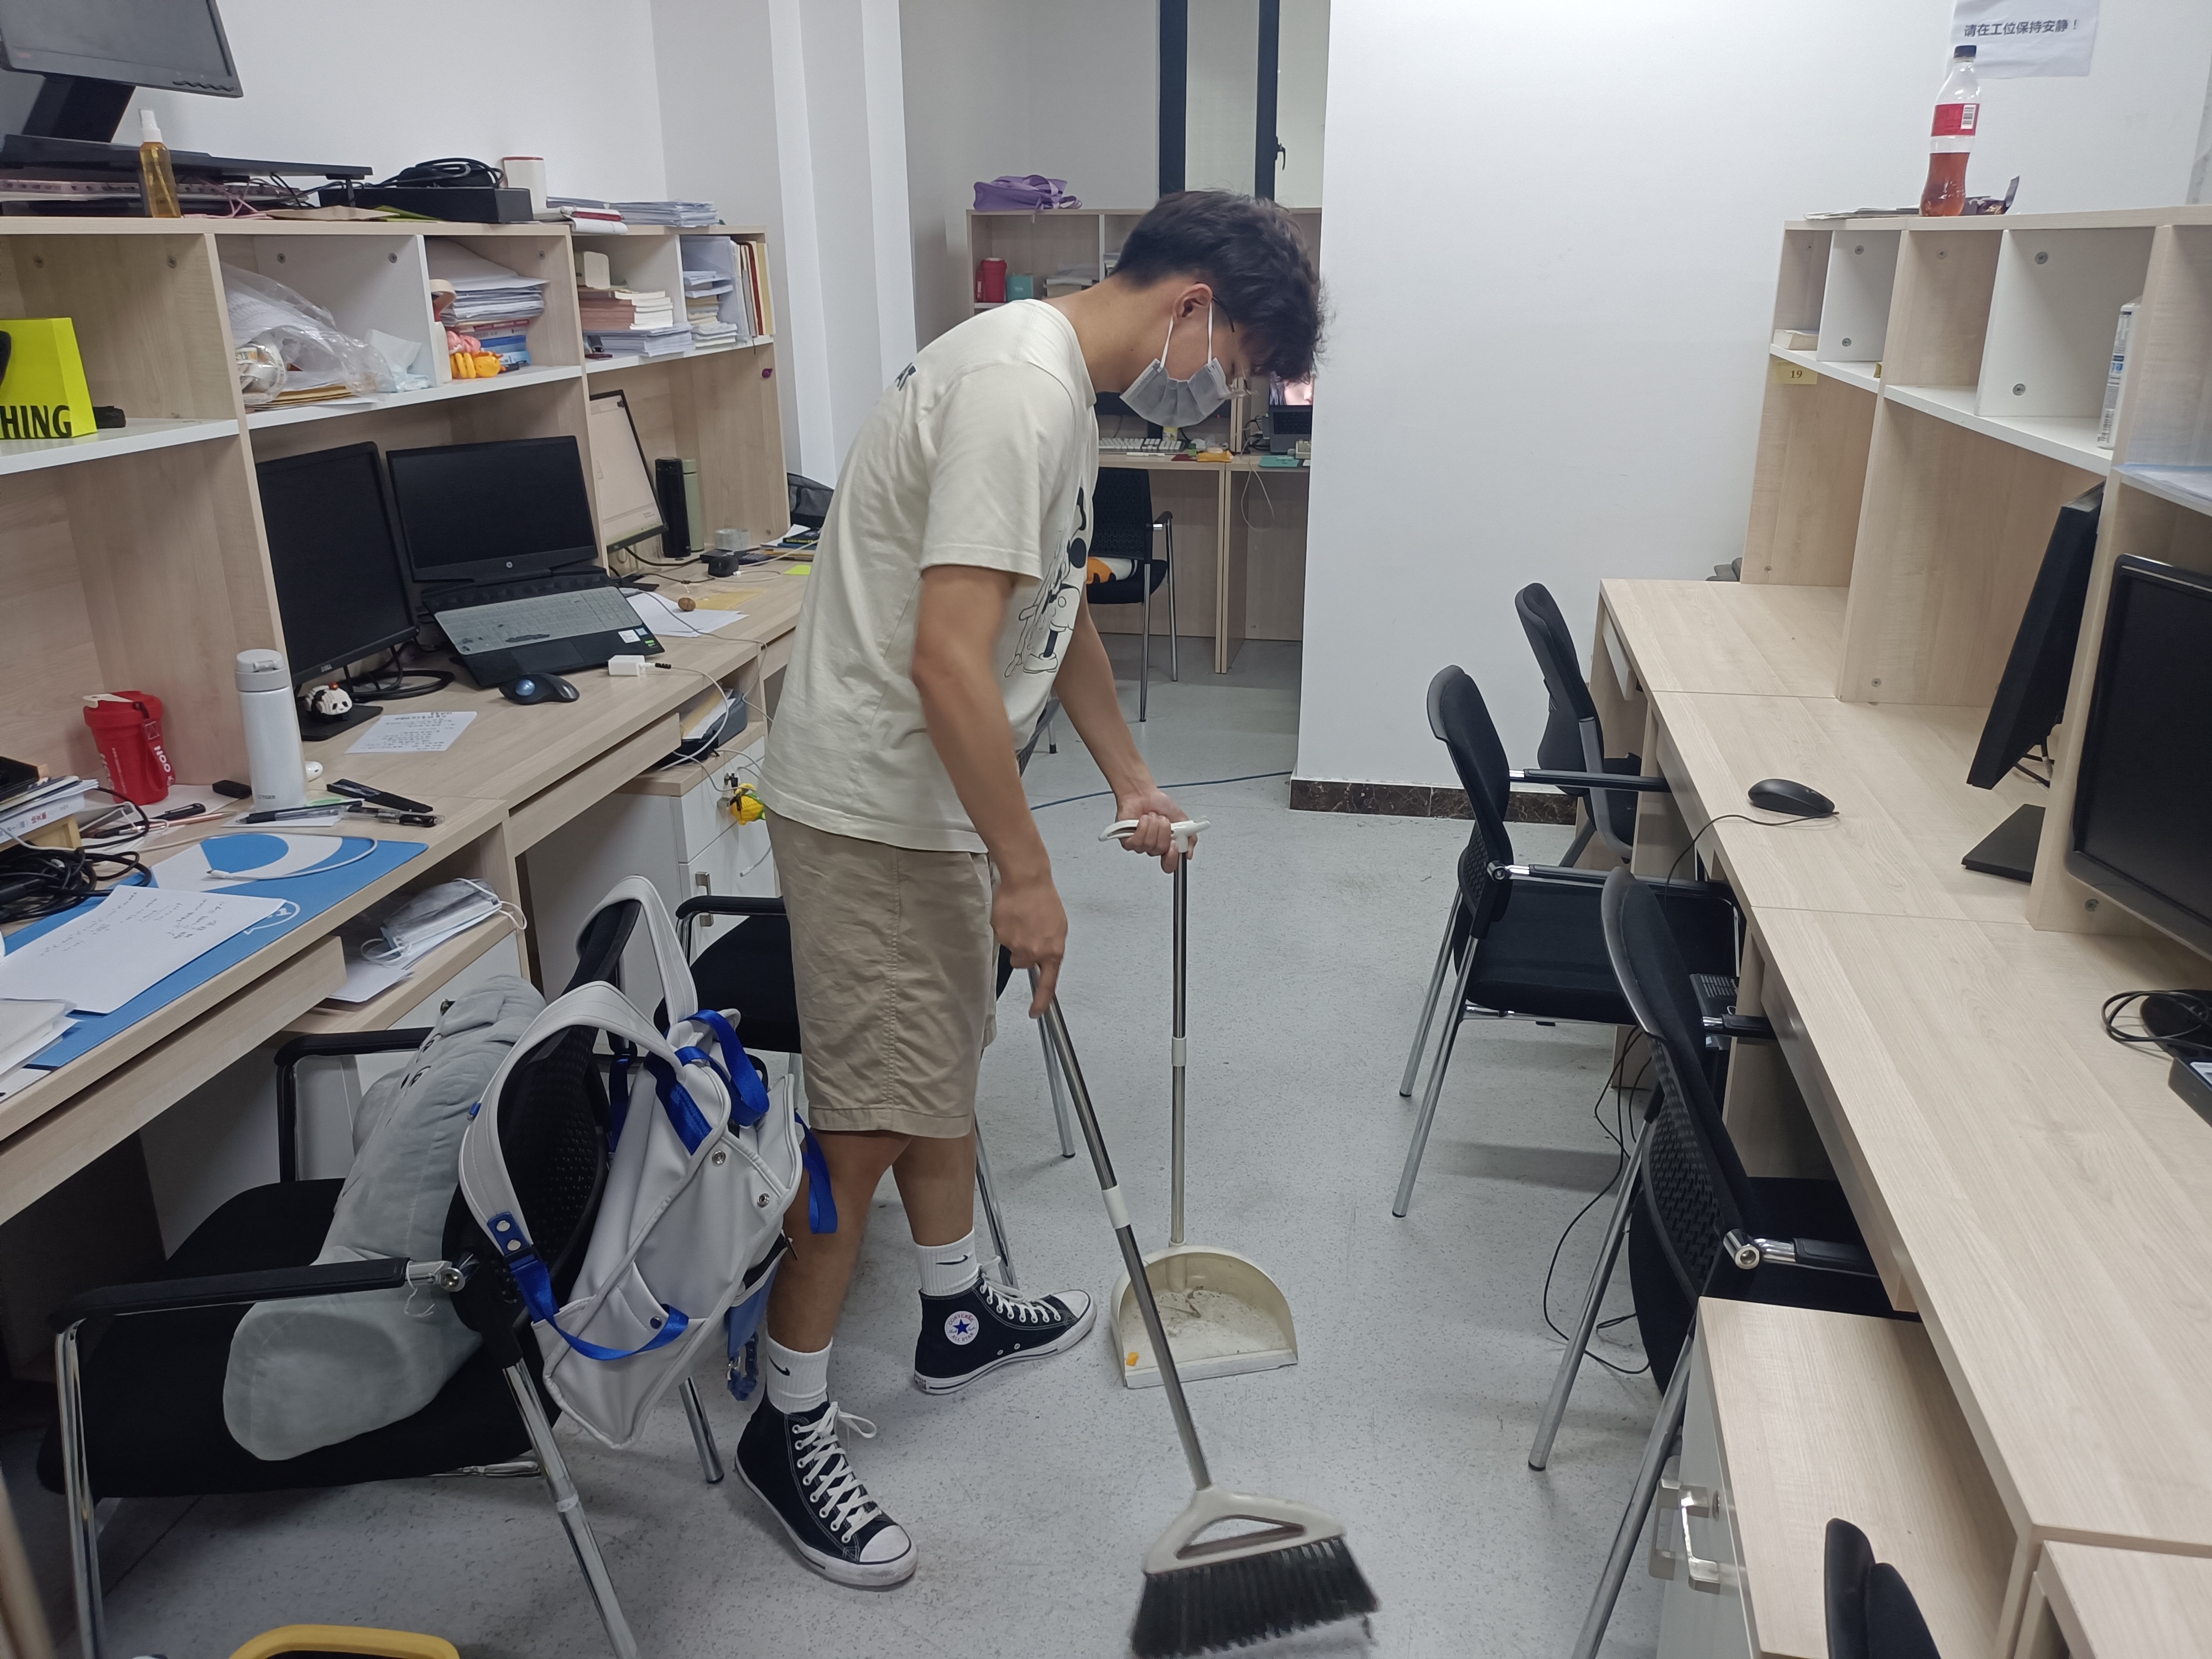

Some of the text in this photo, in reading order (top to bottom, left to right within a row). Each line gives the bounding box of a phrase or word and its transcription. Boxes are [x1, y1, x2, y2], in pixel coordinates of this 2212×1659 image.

[1790, 369, 1803, 379] 19
[948, 1314, 974, 1326] CONVERSE
[961, 1332, 974, 1342] STAR
